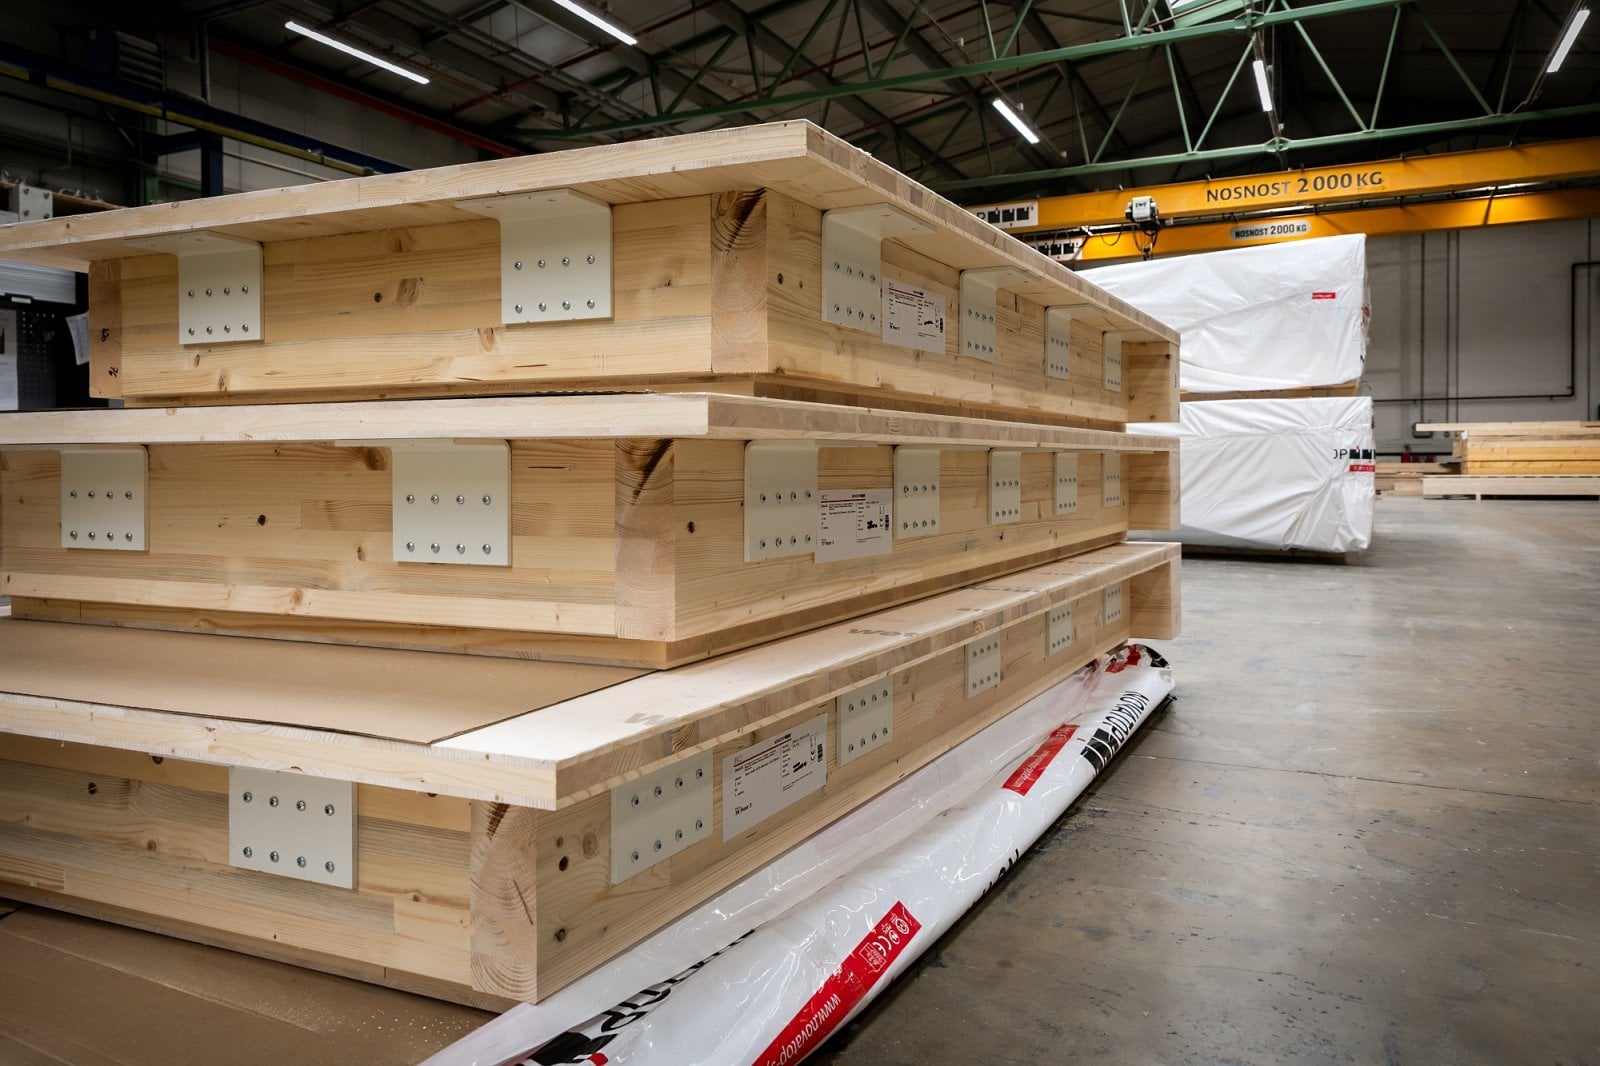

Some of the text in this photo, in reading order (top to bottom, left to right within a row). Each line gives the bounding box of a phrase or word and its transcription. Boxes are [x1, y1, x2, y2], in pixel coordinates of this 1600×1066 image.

[1206, 181, 1291, 203] NOSNOST
[1356, 171, 1383, 187] KG
[1234, 223, 1307, 239] NOSNOST 2000 KG
[1101, 690, 1150, 744] NOVATOP
[766, 992, 842, 1066] www.novatop-
